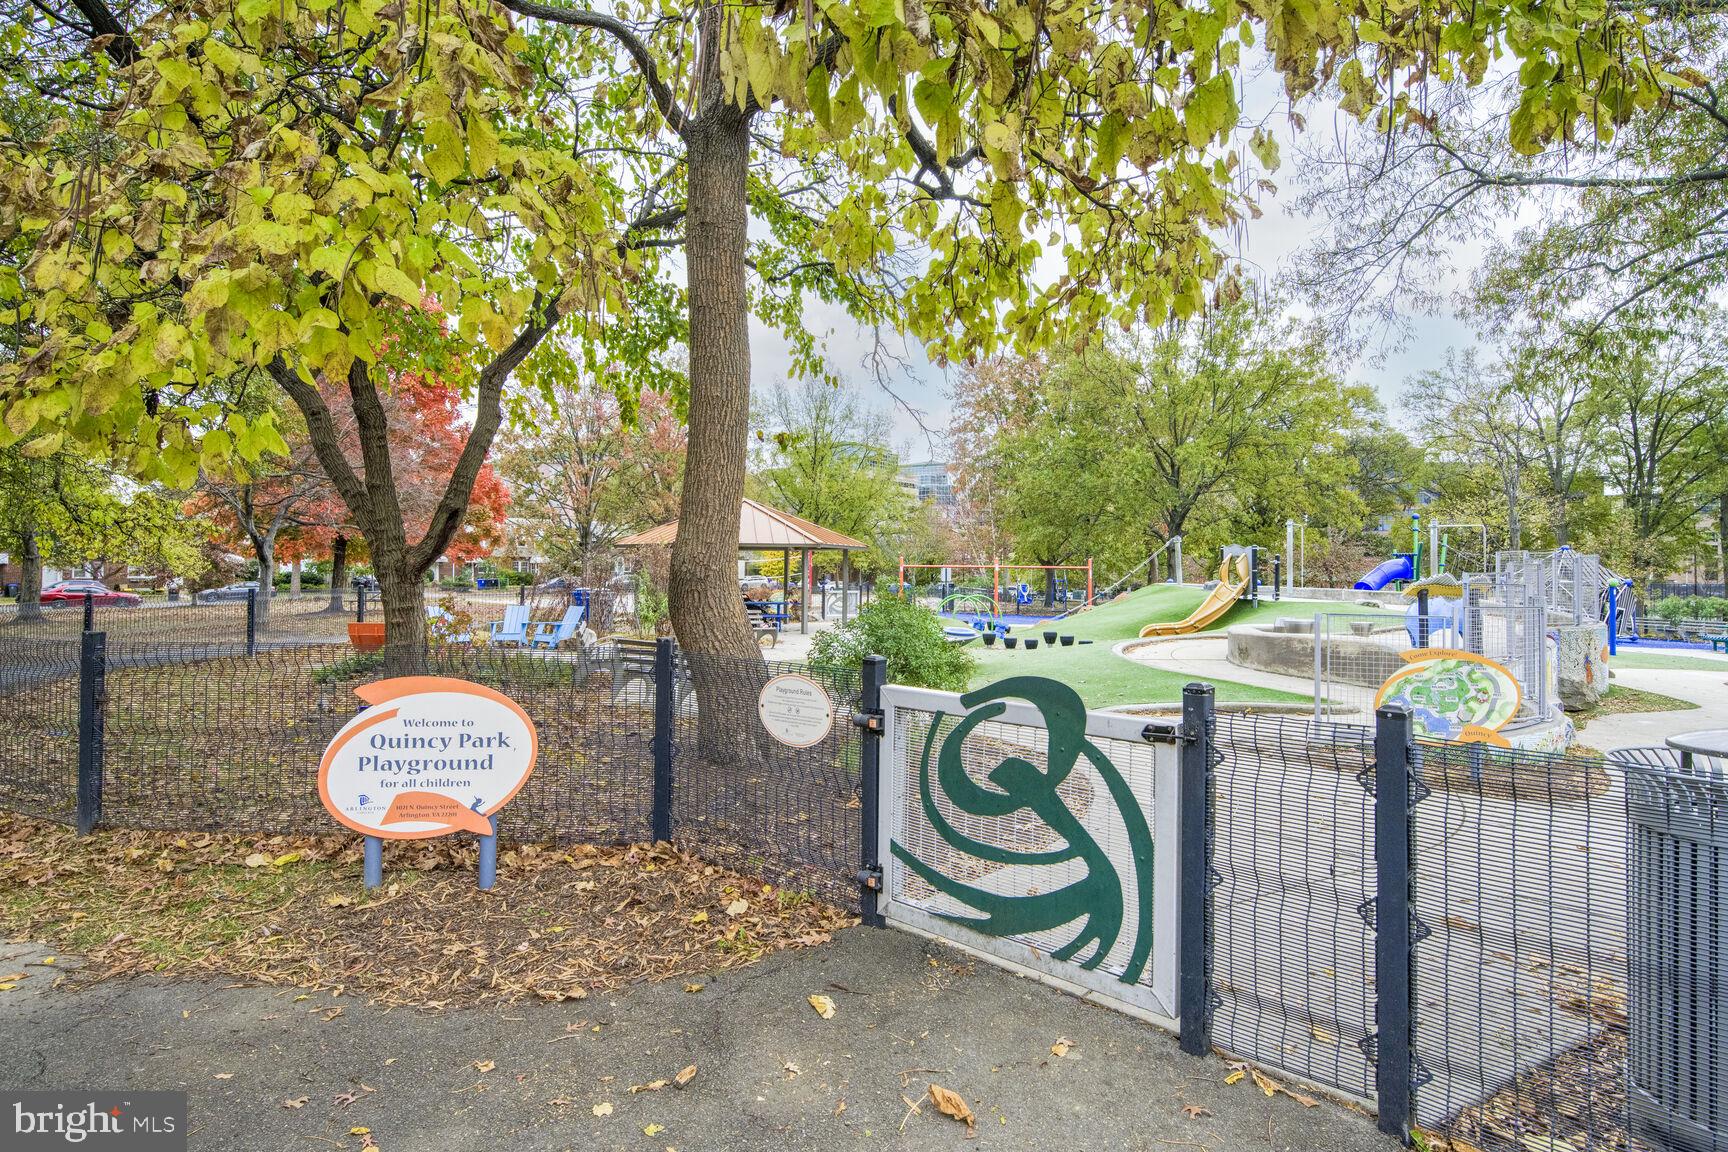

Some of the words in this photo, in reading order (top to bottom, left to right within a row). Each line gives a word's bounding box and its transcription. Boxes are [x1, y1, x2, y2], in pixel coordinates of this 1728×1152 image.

[775, 686, 799, 696] Playground
[799, 688, 812, 697] Rules
[403, 719, 458, 728] Welcome
[461, 719, 474, 728] to
[1464, 730, 1493, 738] Quincy
[370, 733, 452, 752] Quincy
[358, 754, 493, 775] Playground
[380, 779, 399, 788] for
[401, 779, 417, 788] all
[419, 779, 471, 788] children
